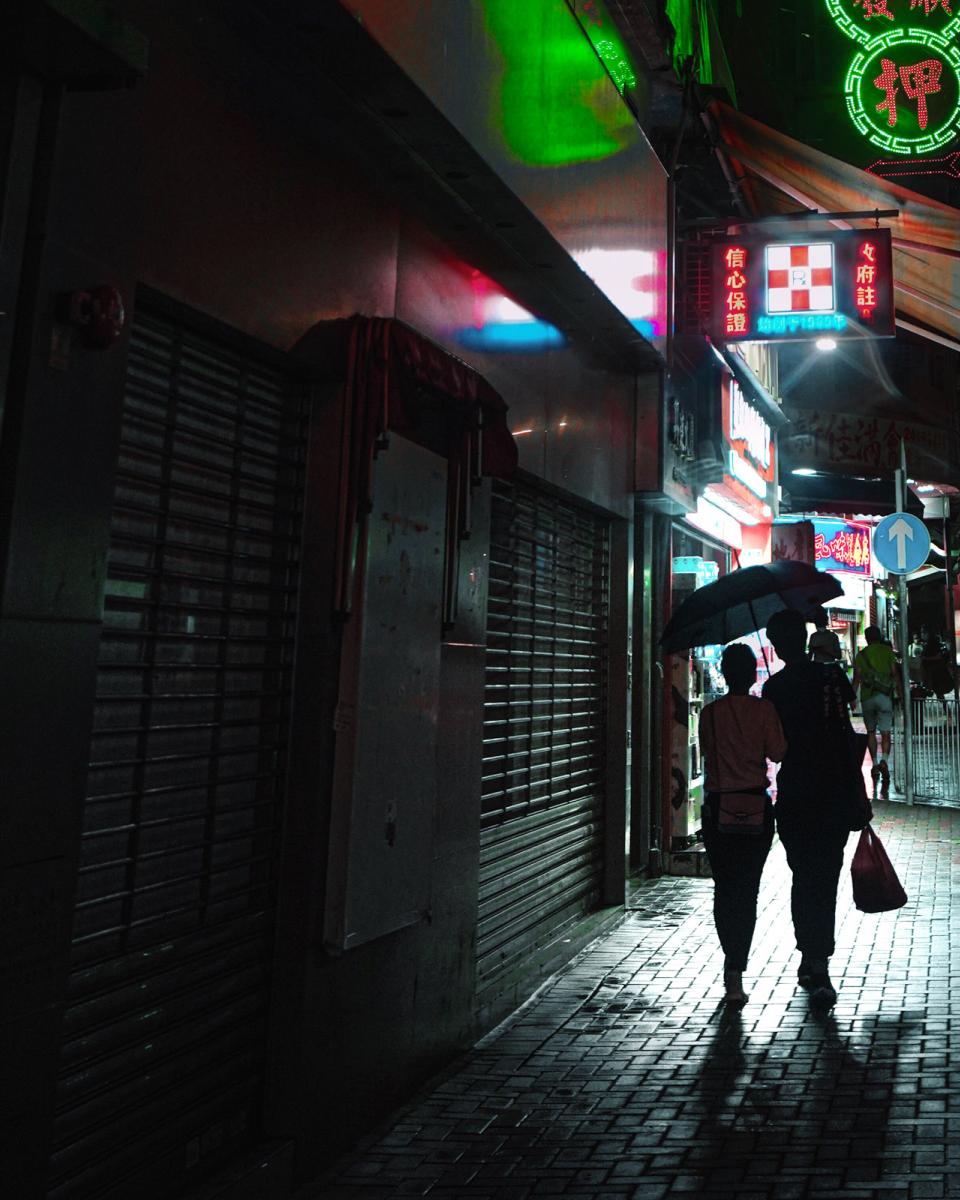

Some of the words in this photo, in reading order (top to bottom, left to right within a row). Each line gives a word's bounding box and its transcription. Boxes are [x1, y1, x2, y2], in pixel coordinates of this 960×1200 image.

[873, 58, 943, 129] 押
[725, 248, 746, 332] 信心保證
[856, 243, 875, 317] 府註
